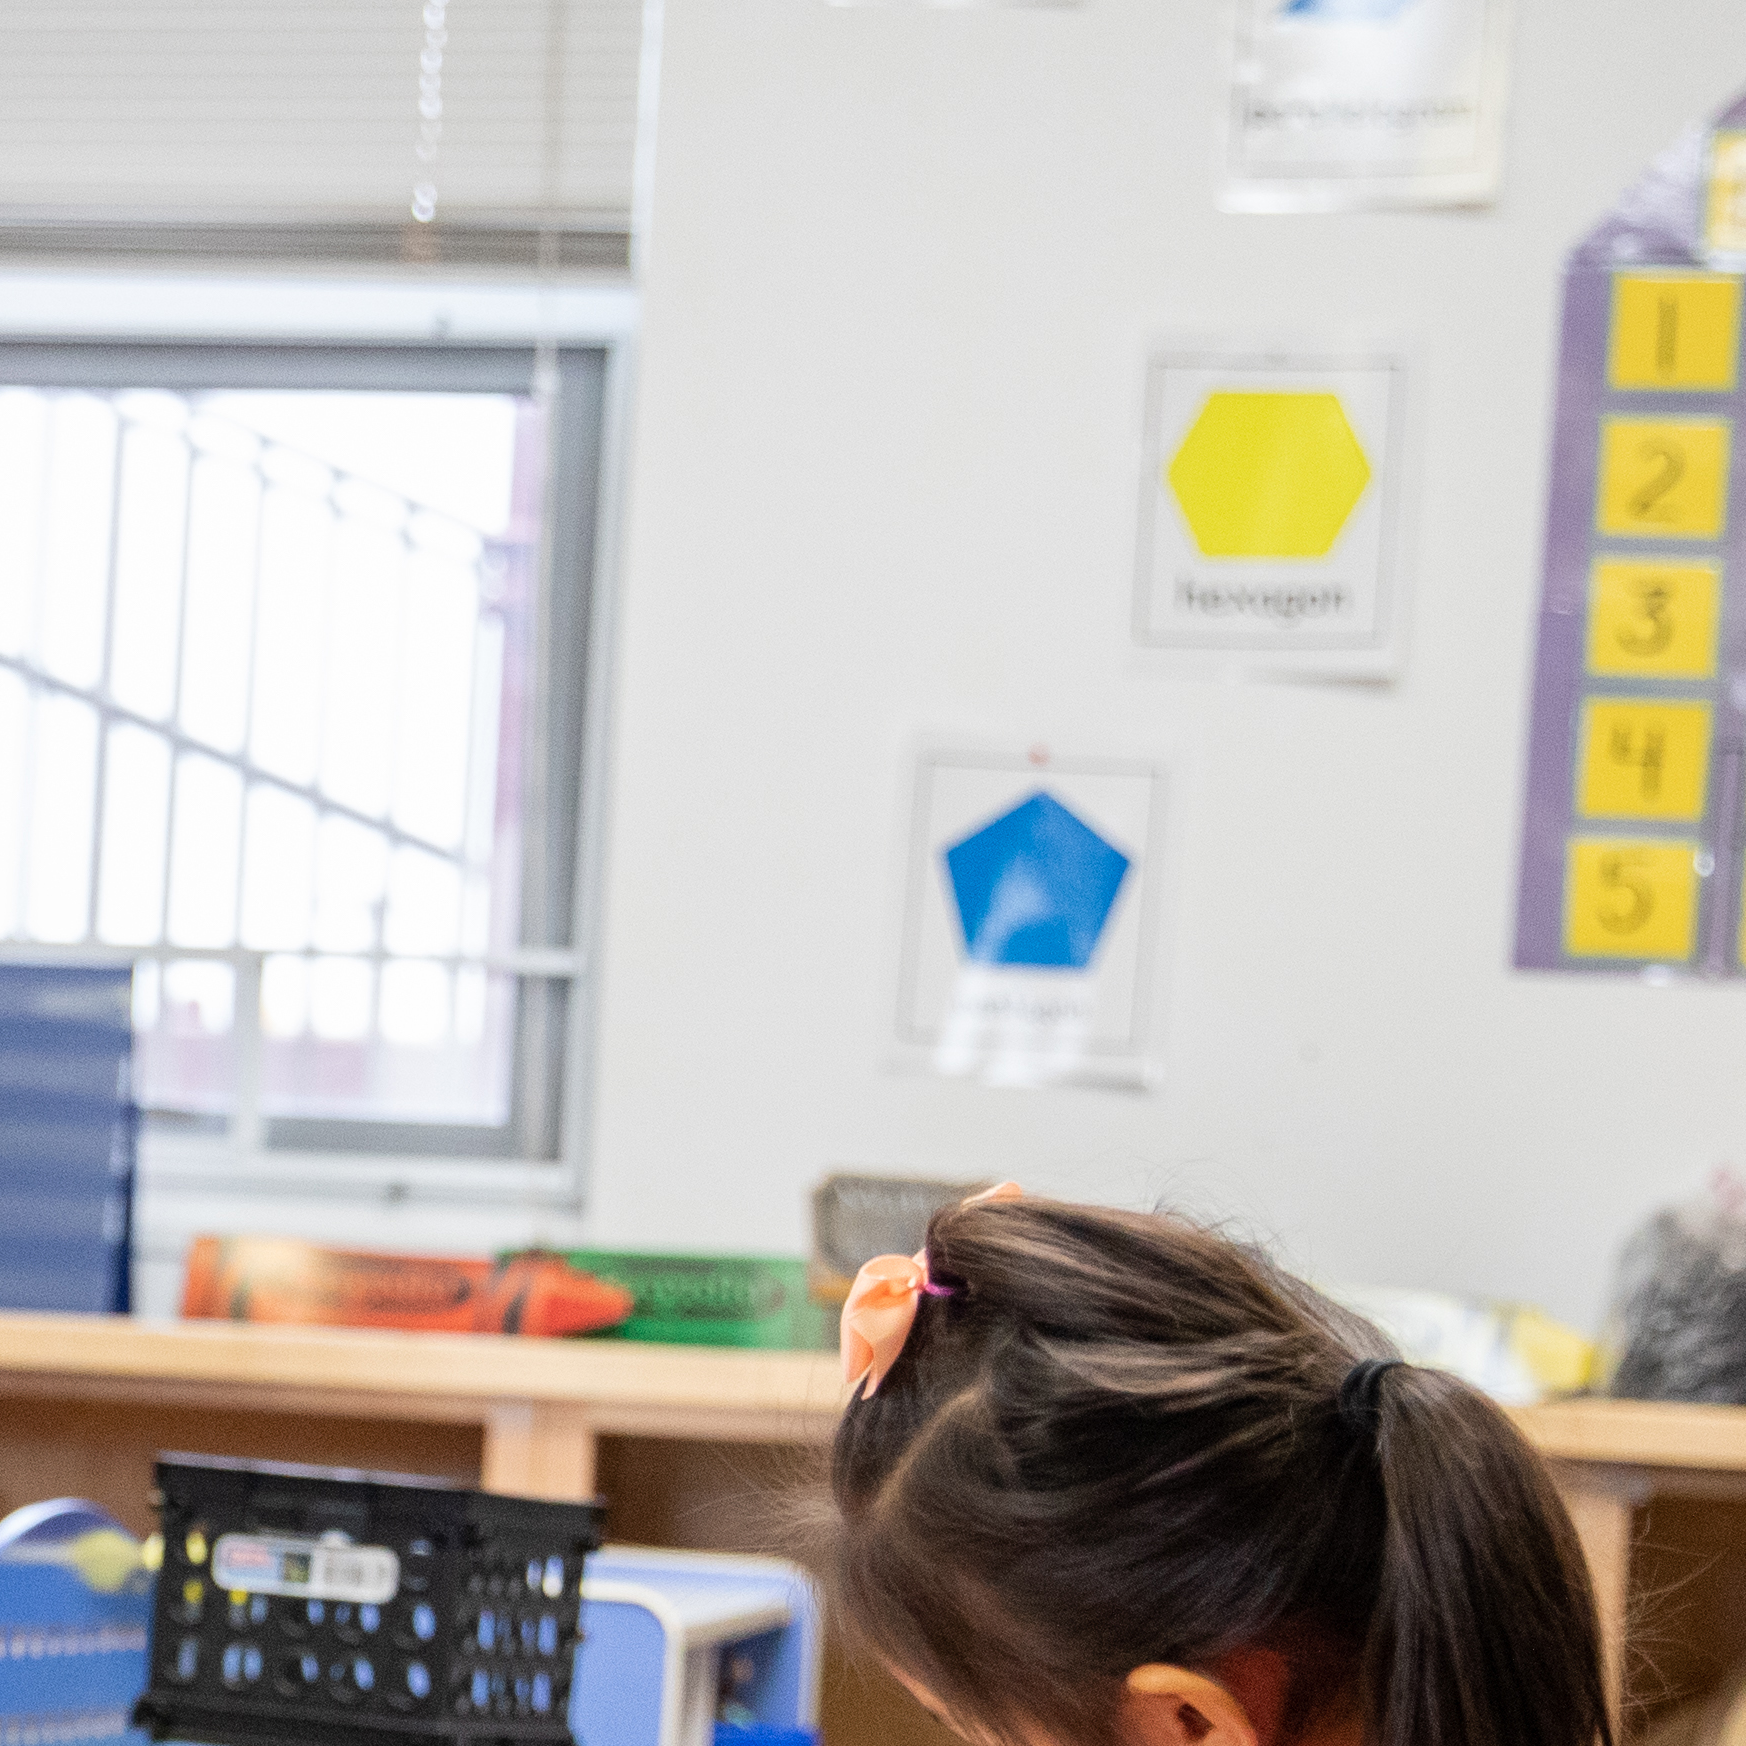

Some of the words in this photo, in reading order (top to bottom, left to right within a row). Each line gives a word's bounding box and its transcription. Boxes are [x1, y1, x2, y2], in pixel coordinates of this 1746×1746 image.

[1655, 289, 1678, 382] 1
[1625, 436, 1688, 525] 2
[1614, 576, 1677, 659] 3
[1608, 720, 1667, 801] 4
[1594, 848, 1658, 937] 5
